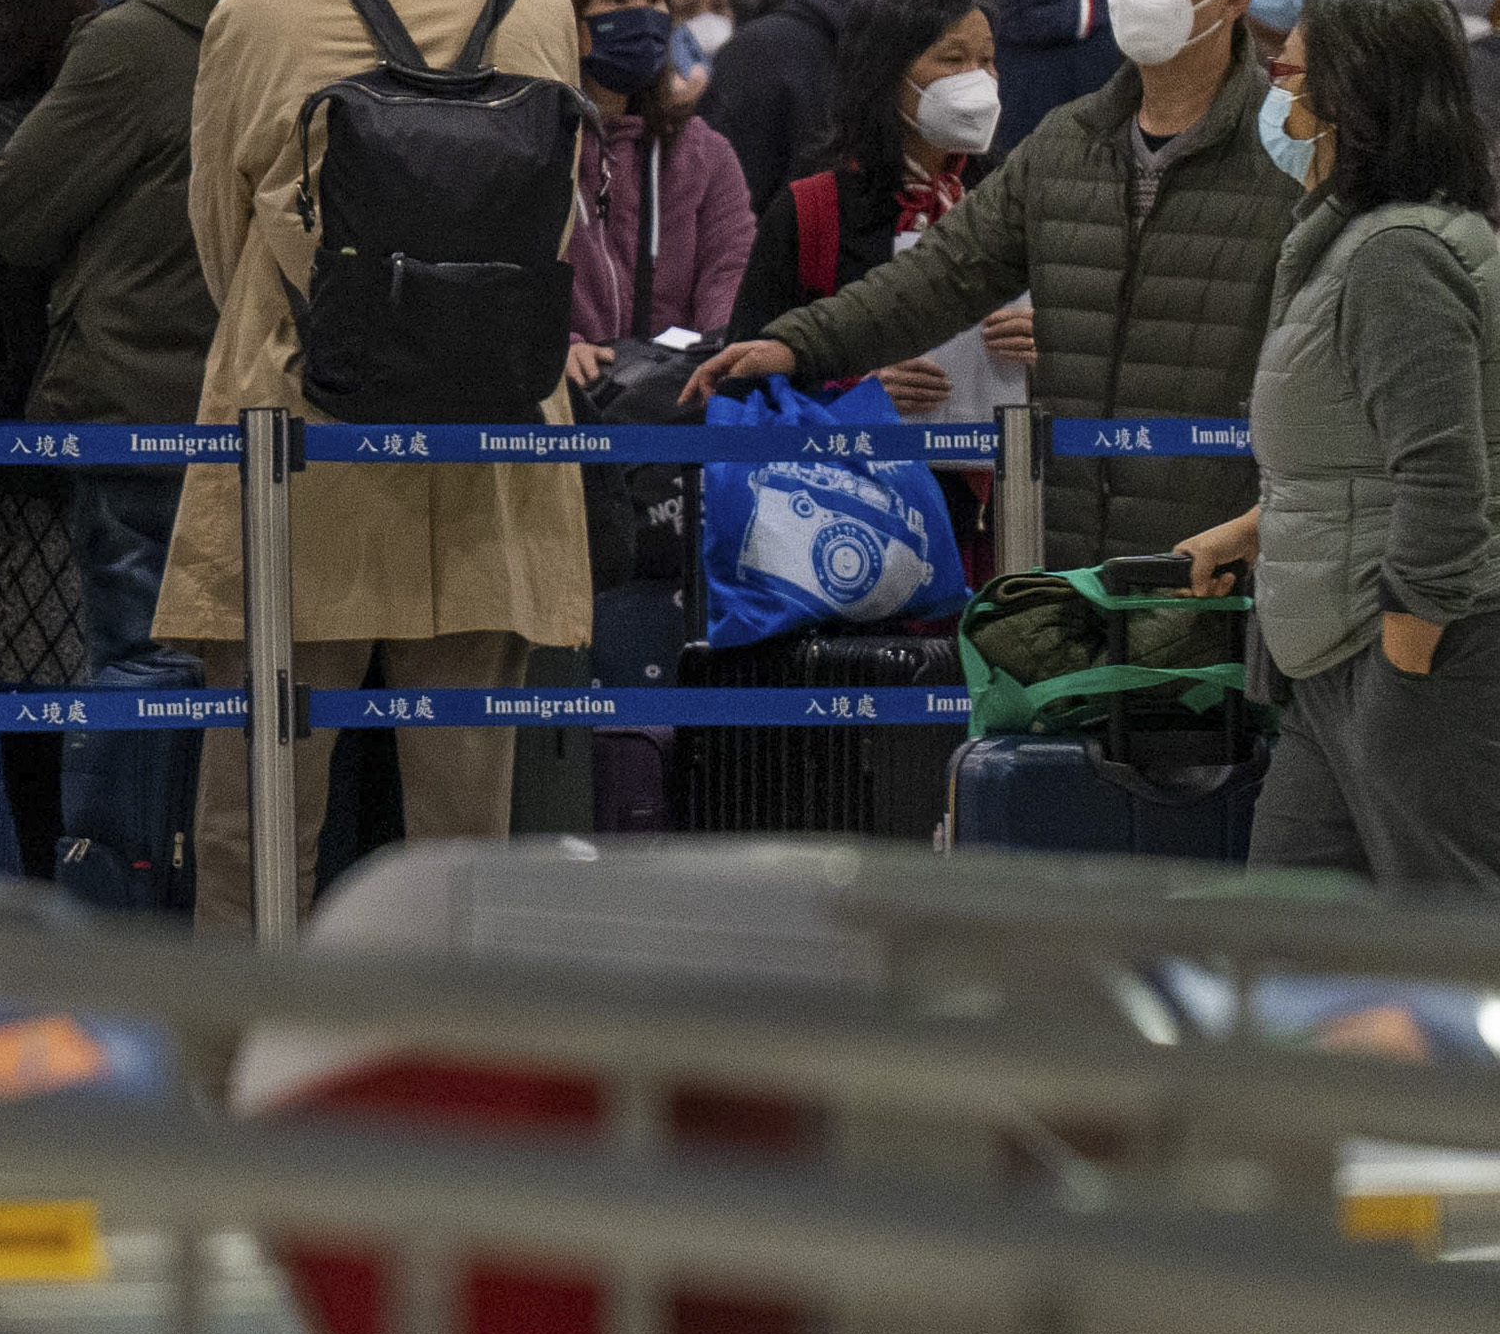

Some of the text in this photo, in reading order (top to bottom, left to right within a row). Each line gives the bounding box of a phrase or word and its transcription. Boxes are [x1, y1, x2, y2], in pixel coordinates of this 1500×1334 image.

[9, 432, 82, 458] 入境處
[356, 430, 612, 458] 入境處 Immigration
[801, 431, 876, 457] 入境處
[1094, 425, 1153, 451] 入境處
[15, 699, 89, 725] 入境處
[363, 694, 617, 721] 入境處 Immigration
[804, 695, 878, 721] 入境處
